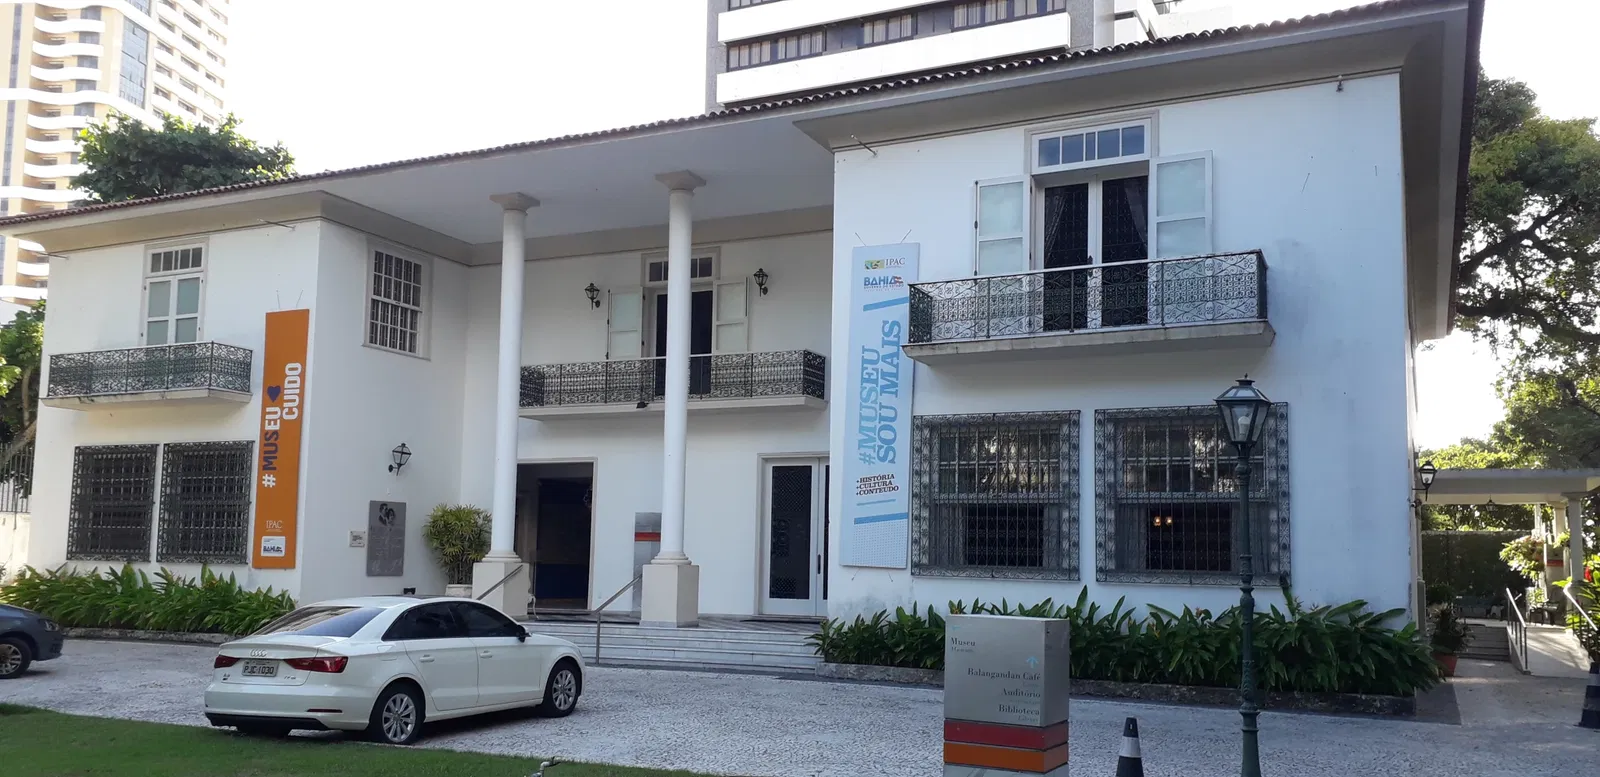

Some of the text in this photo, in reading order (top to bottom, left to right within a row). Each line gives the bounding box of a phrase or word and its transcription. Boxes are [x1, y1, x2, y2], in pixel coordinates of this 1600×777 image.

[885, 257, 906, 266] IPAC
[863, 275, 897, 286] BAHIA
[282, 362, 302, 420] CUIDO
[877, 320, 901, 465] SOU MAIS
[951, 637, 976, 647] Museu
[1023, 671, 1041, 681] Café
[1002, 687, 1041, 698] Auditório
[999, 704, 1040, 716] Biblioteca
